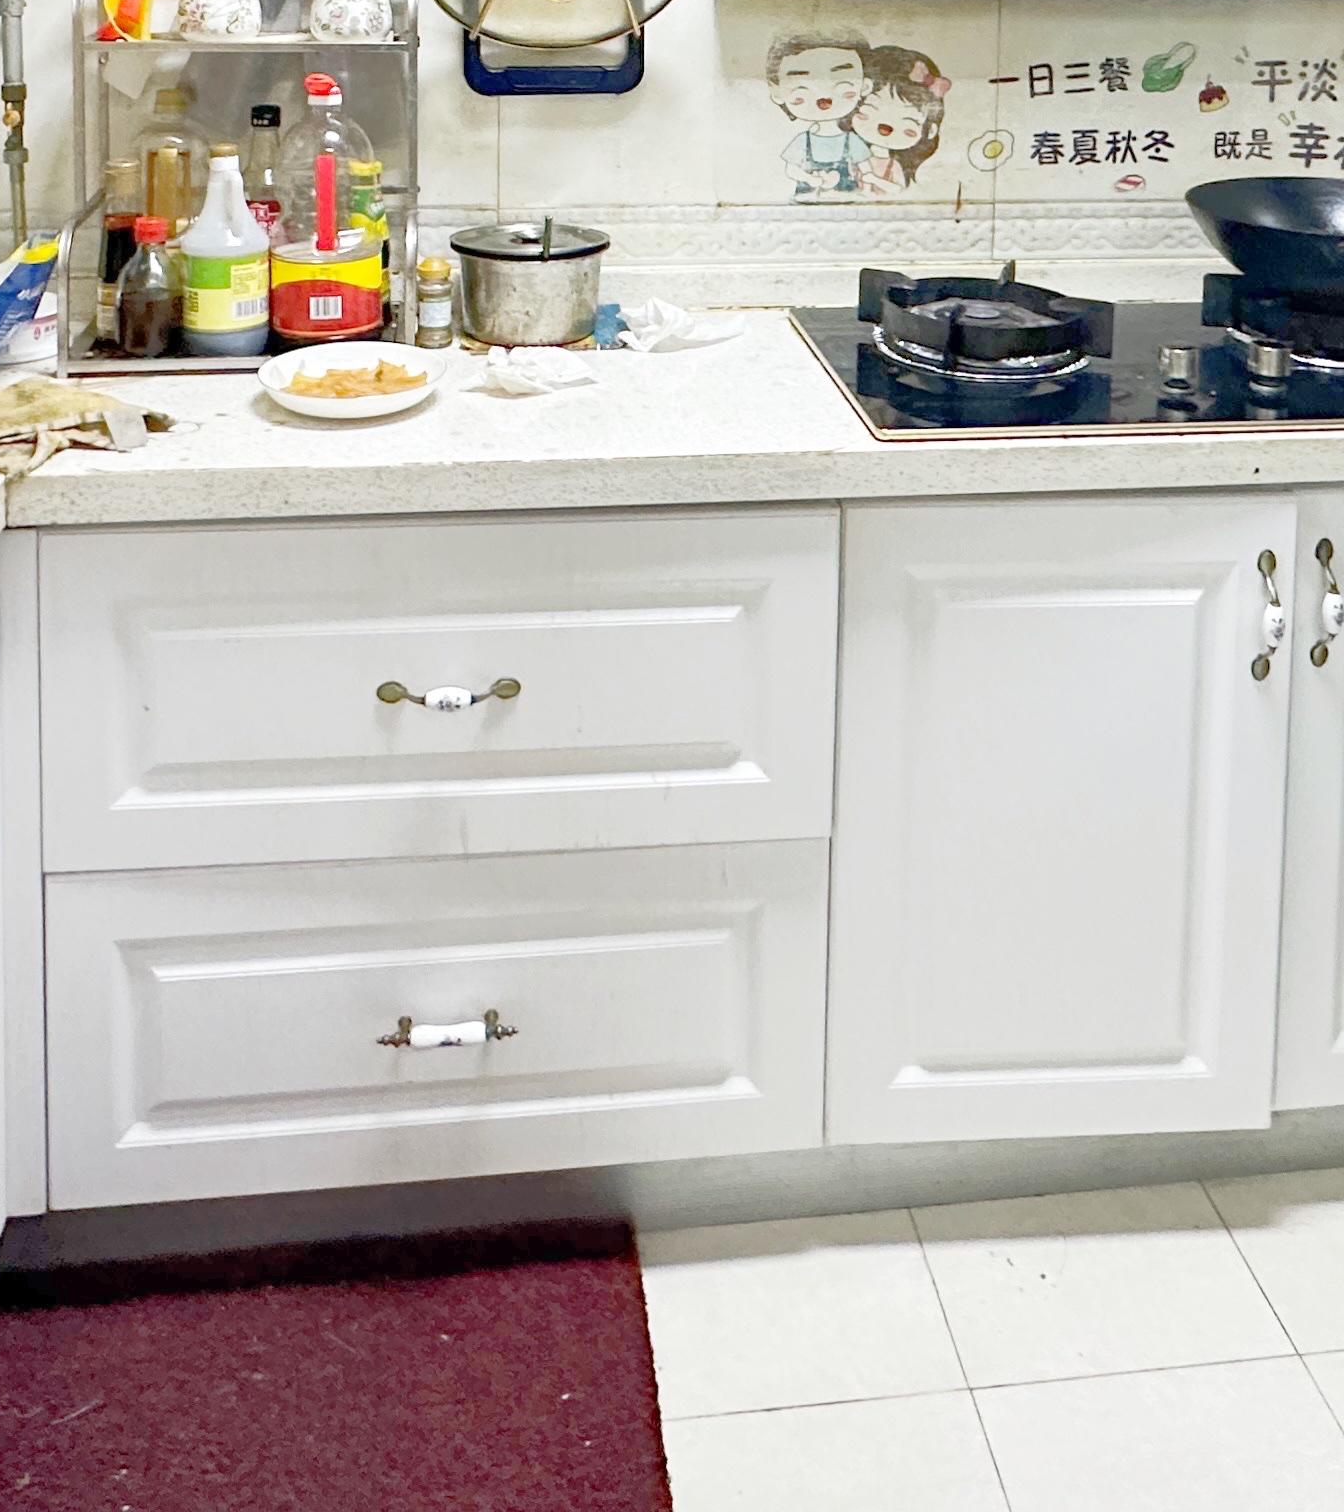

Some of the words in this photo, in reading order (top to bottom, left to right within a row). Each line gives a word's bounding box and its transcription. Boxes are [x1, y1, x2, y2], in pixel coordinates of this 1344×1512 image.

[989, 57, 1133, 97] 一日三餐
[1251, 59, 1340, 103] 平淡
[1030, 129, 1175, 166] 春夏秋冬
